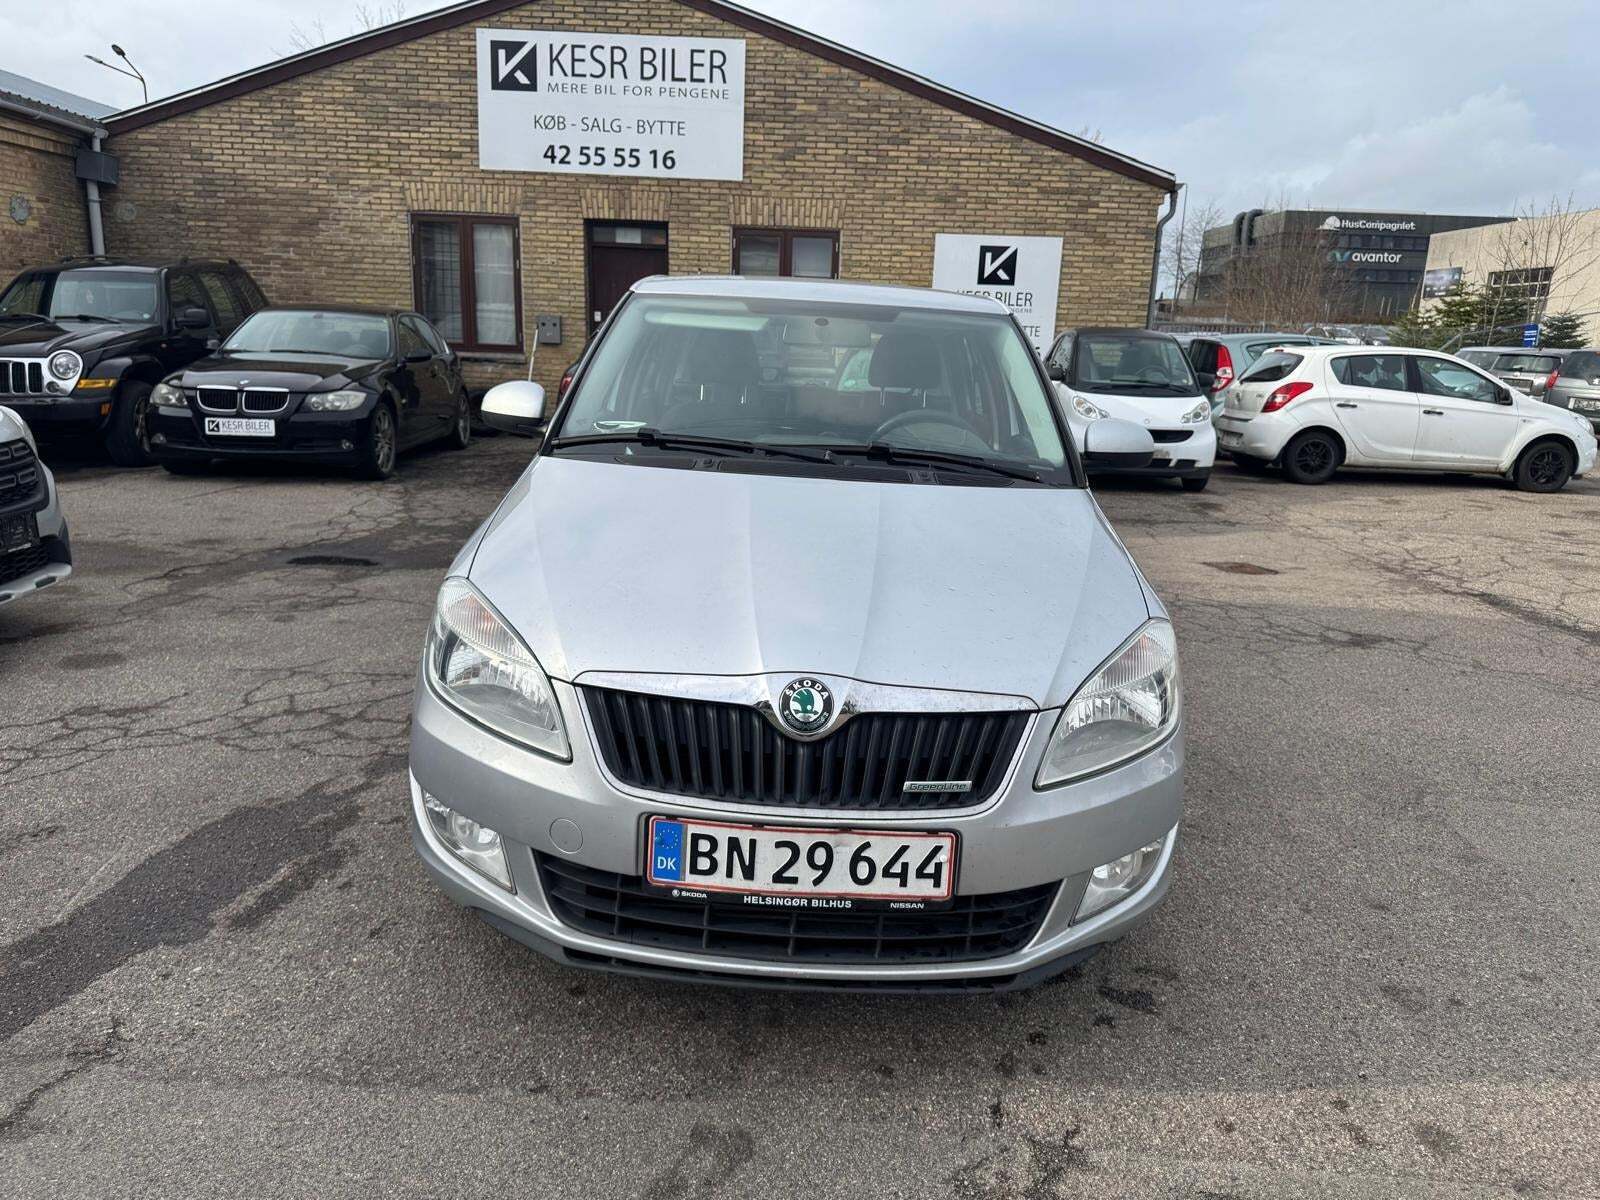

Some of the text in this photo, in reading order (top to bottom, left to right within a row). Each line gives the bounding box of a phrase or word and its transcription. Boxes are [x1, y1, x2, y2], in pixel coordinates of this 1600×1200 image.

[549, 43, 727, 84] KESR BILER
[547, 82, 729, 99] MERE BIL FOR PENGENE
[533, 114, 566, 131] KØB
[580, 116, 622, 133] SALG
[636, 119, 686, 136] BYTTE
[543, 144, 676, 169] 42 55 55 16
[1341, 219, 1416, 231] HusCompagniet
[1351, 252, 1402, 263] avantor
[222, 420, 271, 431] KESR BILER
[656, 855, 676, 871] DK
[688, 832, 944, 889] BN 29 644
[743, 895, 852, 909] HELSINGØR BILHUS
